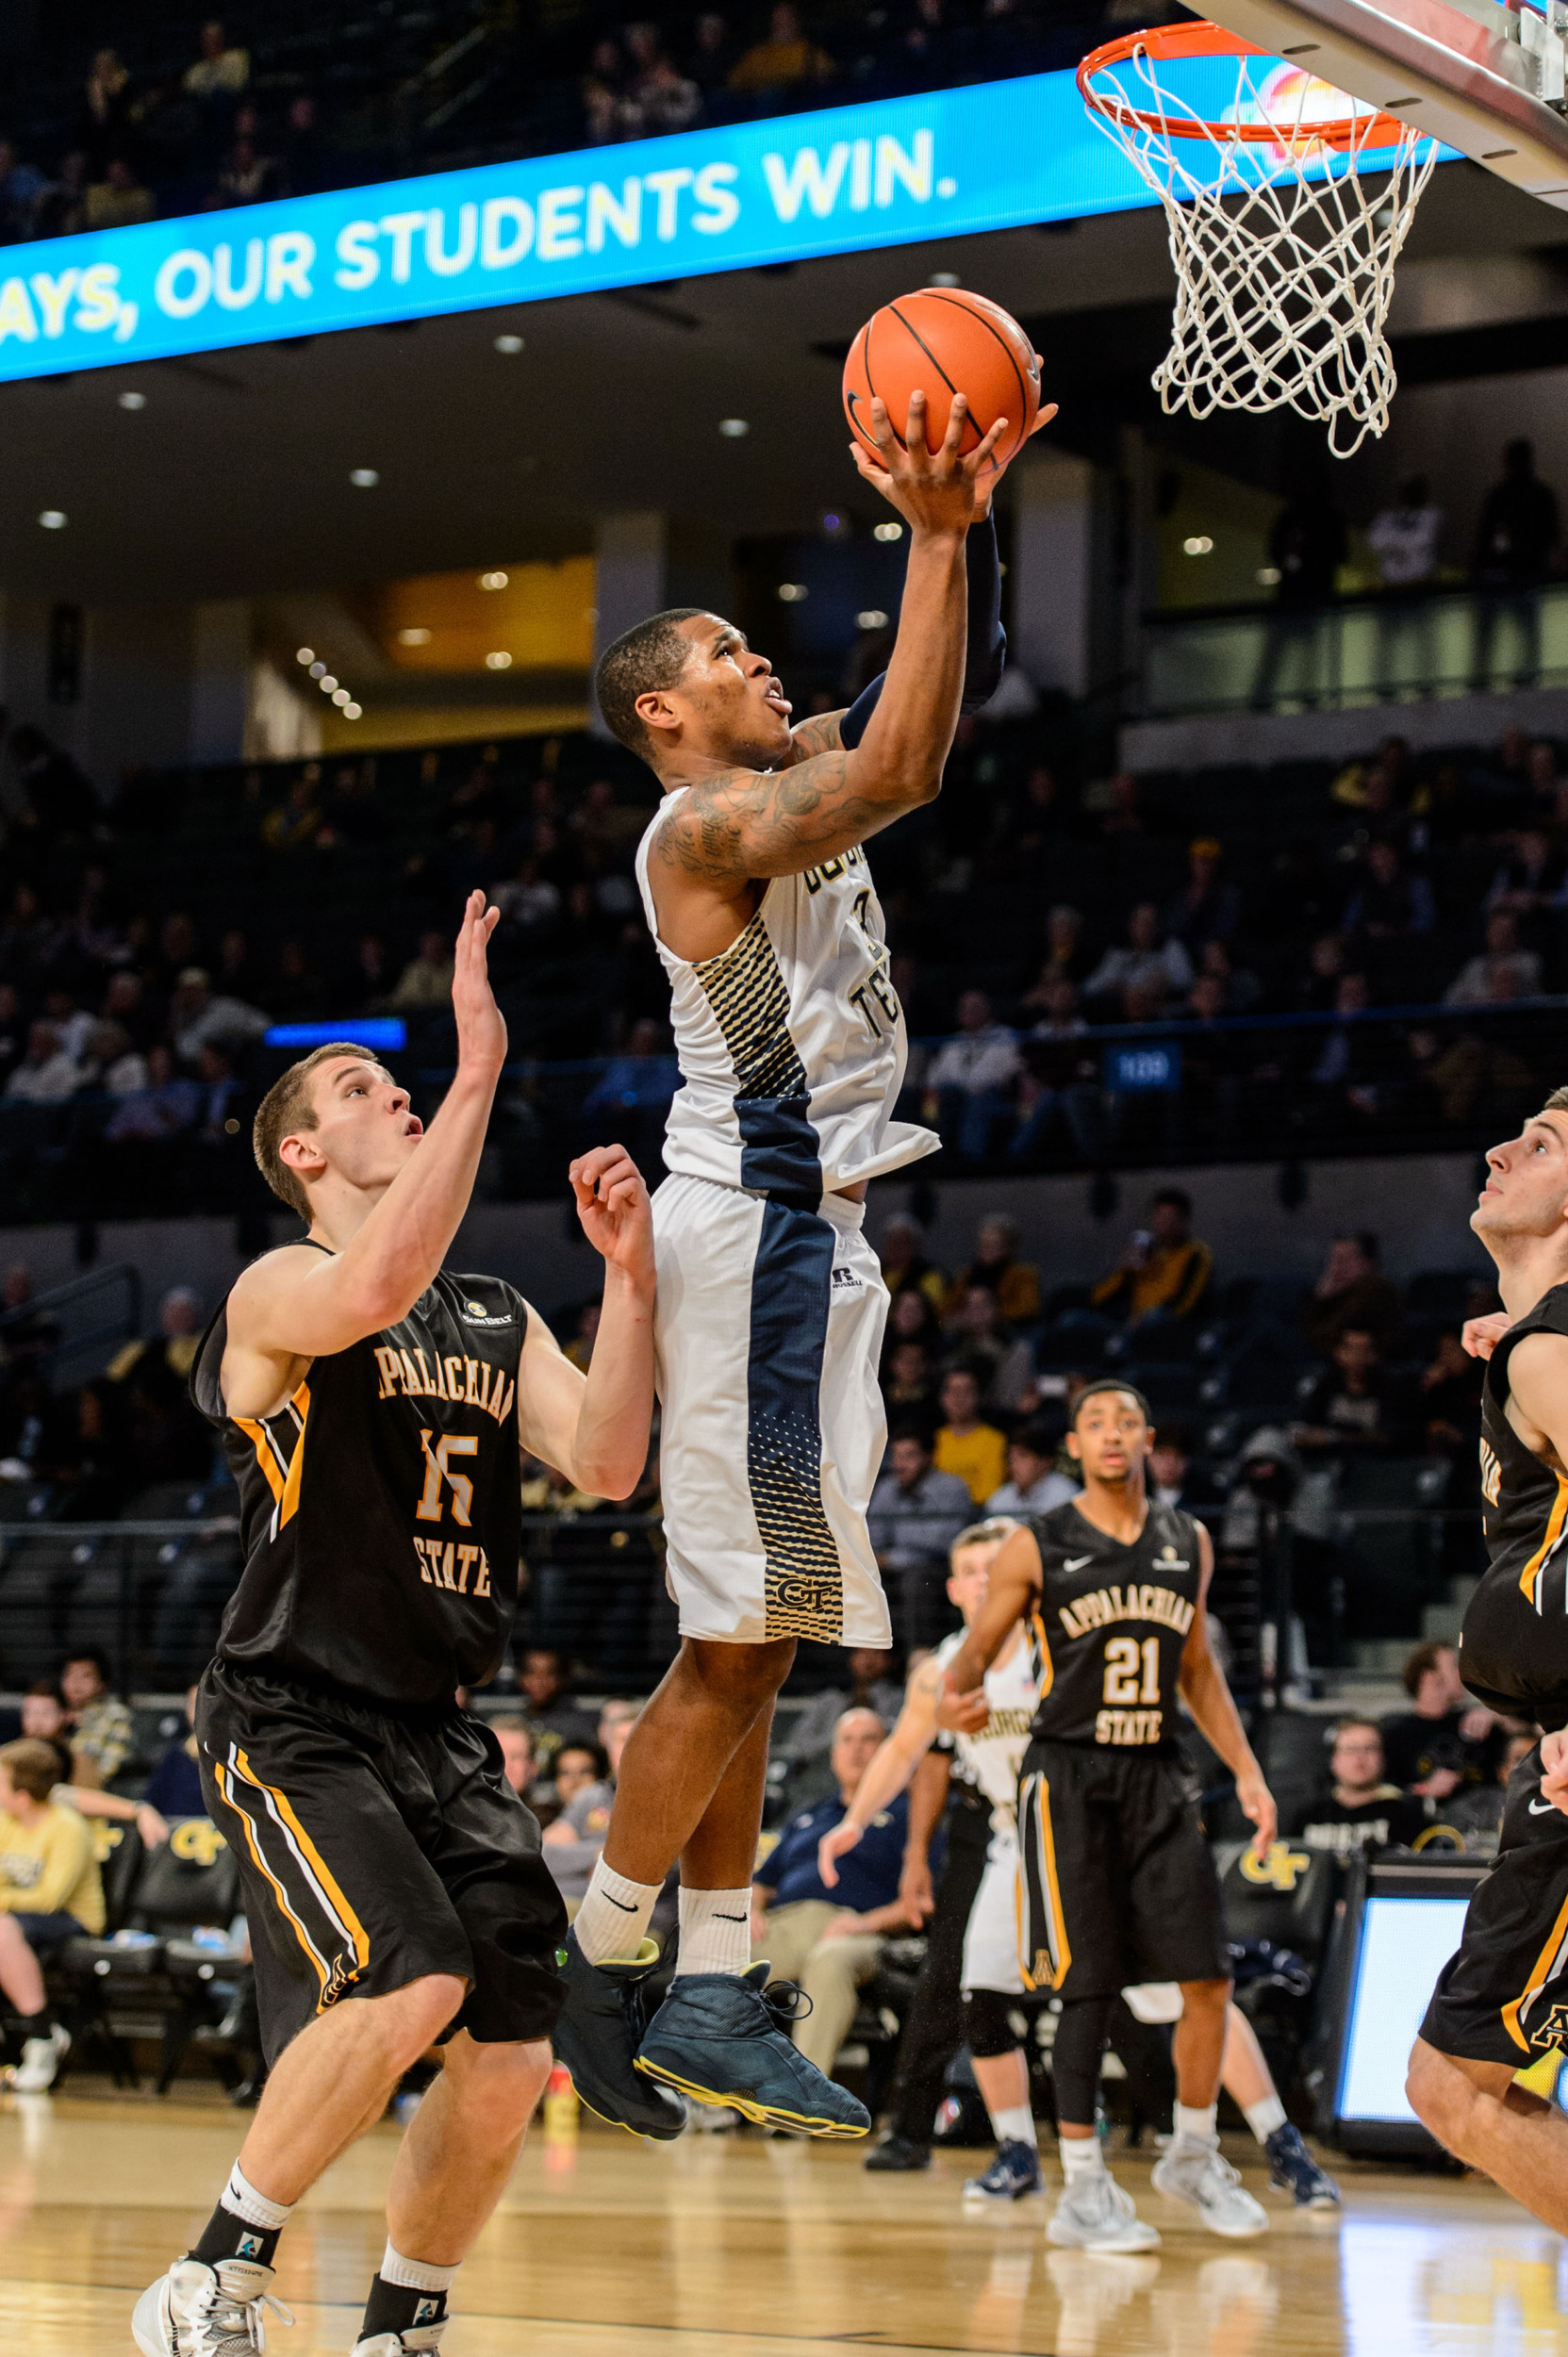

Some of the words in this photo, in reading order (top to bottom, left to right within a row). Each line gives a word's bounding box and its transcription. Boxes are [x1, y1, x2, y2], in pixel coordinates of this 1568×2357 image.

[154, 230, 316, 321] OUR
[334, 161, 742, 291] STUDENTS
[761, 127, 959, 223] WIN.
[416, 1428, 479, 1526] 15
[413, 1536, 491, 1597] STATE
[776, 1577, 834, 1612] GT
[1058, 1583, 1196, 1640] APPALACHIAN
[1102, 1637, 1161, 1705] 21
[1095, 1709, 1163, 1745] STATE
